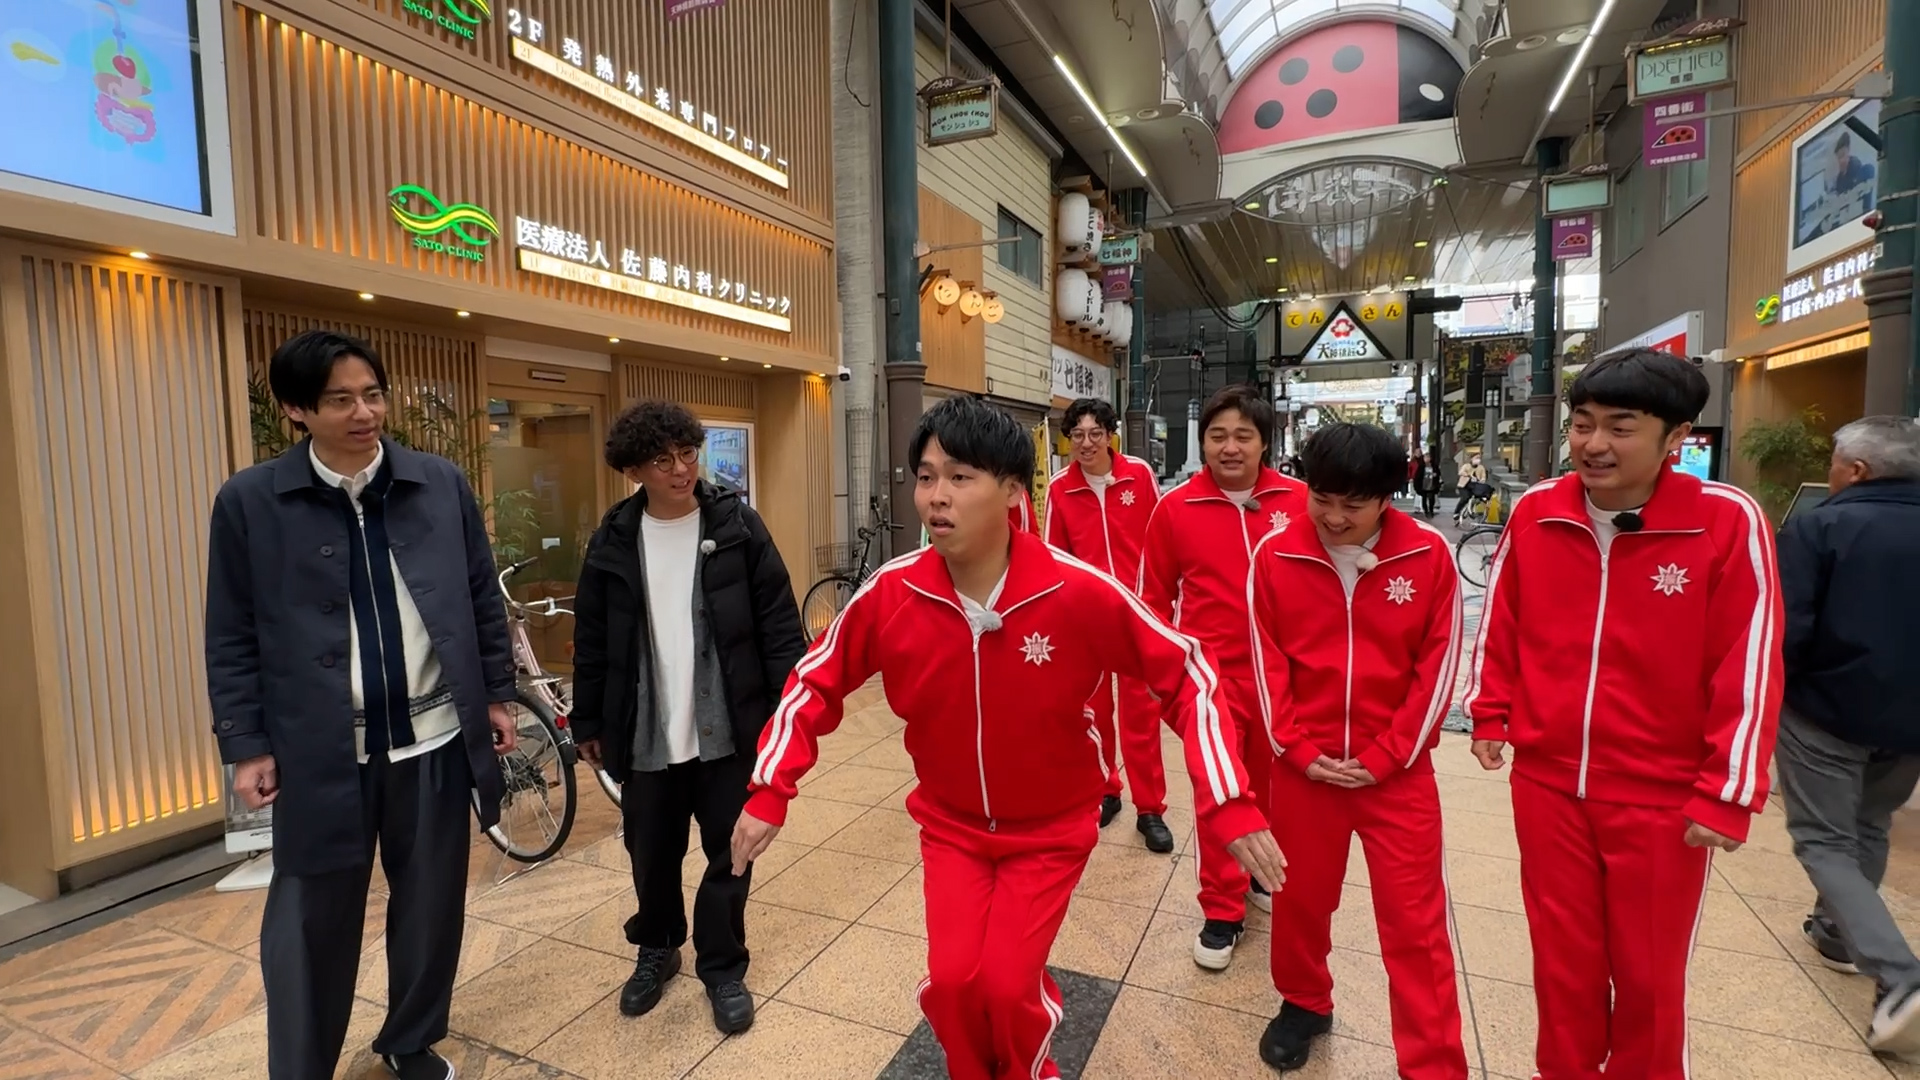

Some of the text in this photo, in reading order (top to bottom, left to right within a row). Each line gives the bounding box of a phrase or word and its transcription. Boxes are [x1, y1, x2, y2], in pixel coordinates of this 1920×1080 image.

[403, 0, 474, 39] SATO CLINIC
[1641, 51, 1724, 80] PREMIER
[507, 9, 789, 168] 2F 発熱外来専門フロアー
[414, 237, 484, 262] SATO CLINIC
[516, 216, 611, 270] 医療法人
[620, 248, 791, 315] 佐藤内科クリニック
